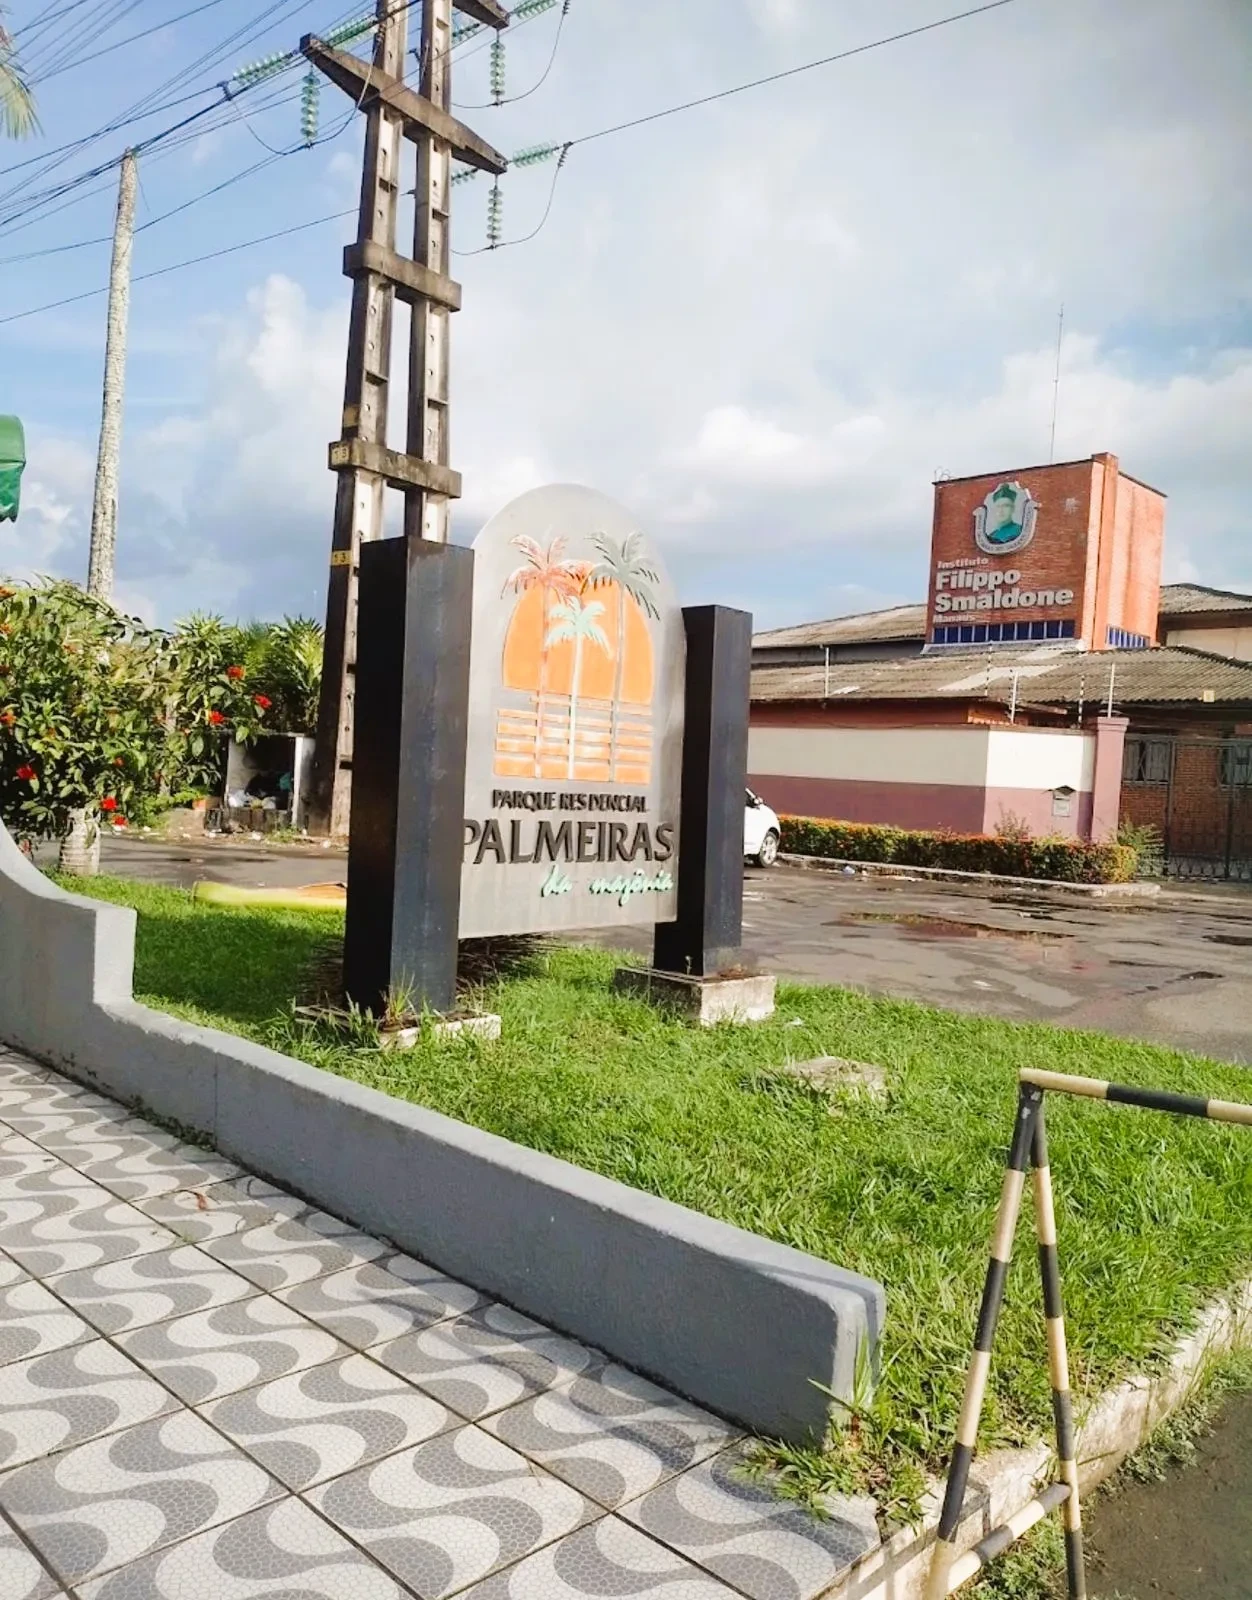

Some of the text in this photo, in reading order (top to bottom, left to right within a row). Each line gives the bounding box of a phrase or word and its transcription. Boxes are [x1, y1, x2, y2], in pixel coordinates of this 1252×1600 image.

[937, 557, 989, 569] Instituto
[935, 569, 1021, 592] Filippo
[934, 588, 1074, 613] Smaldone
[492, 789, 650, 813] PARQUE RESDENCIAL
[463, 819, 675, 865] PALMEIRAS
